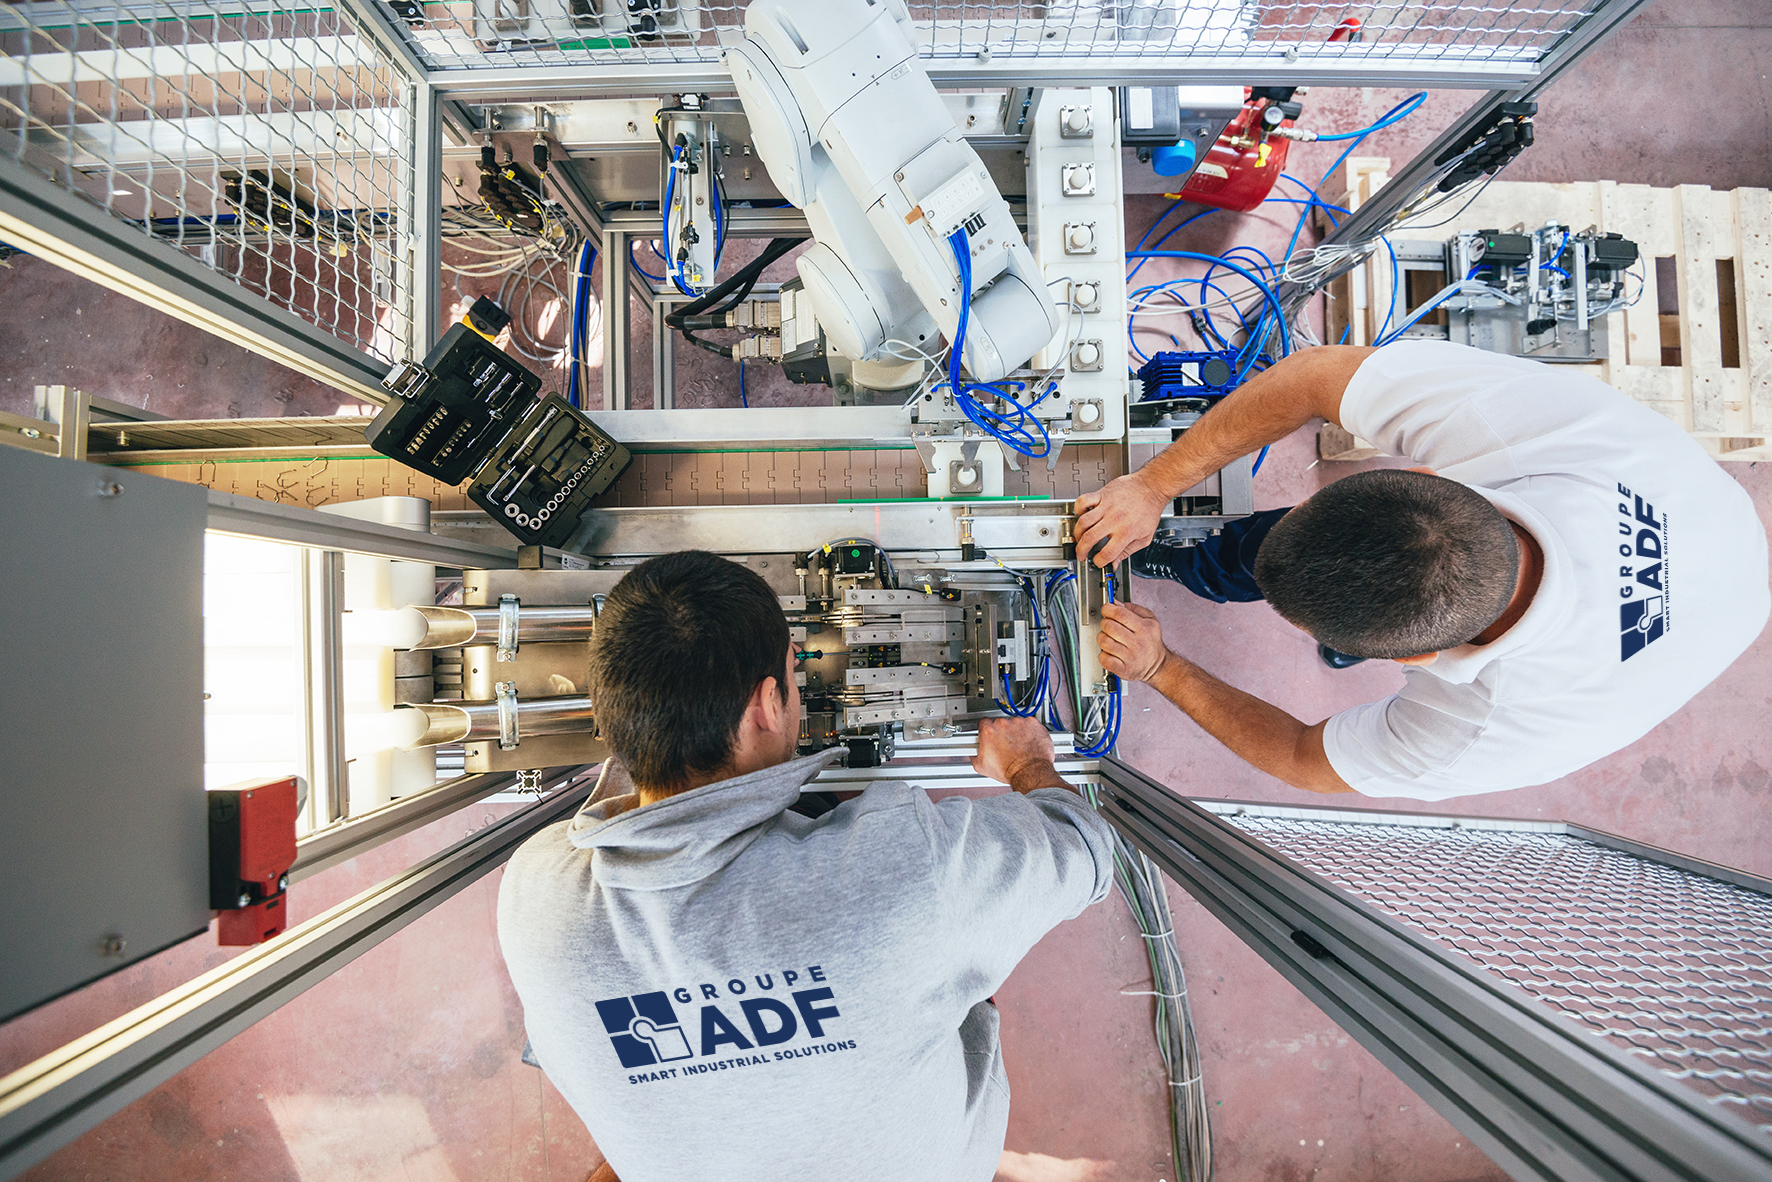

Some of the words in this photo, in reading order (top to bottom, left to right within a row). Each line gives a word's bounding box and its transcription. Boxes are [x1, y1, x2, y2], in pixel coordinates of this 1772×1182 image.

[1617, 482, 1633, 598] GROUPE
[1634, 493, 1663, 591] ADF
[673, 965, 827, 1004] GROUPE
[700, 986, 841, 1057] ADF
[628, 1068, 677, 1085] SMART
[682, 1054, 770, 1077] INDUSTRIAL
[774, 1039, 857, 1061] SOLUTIONS
